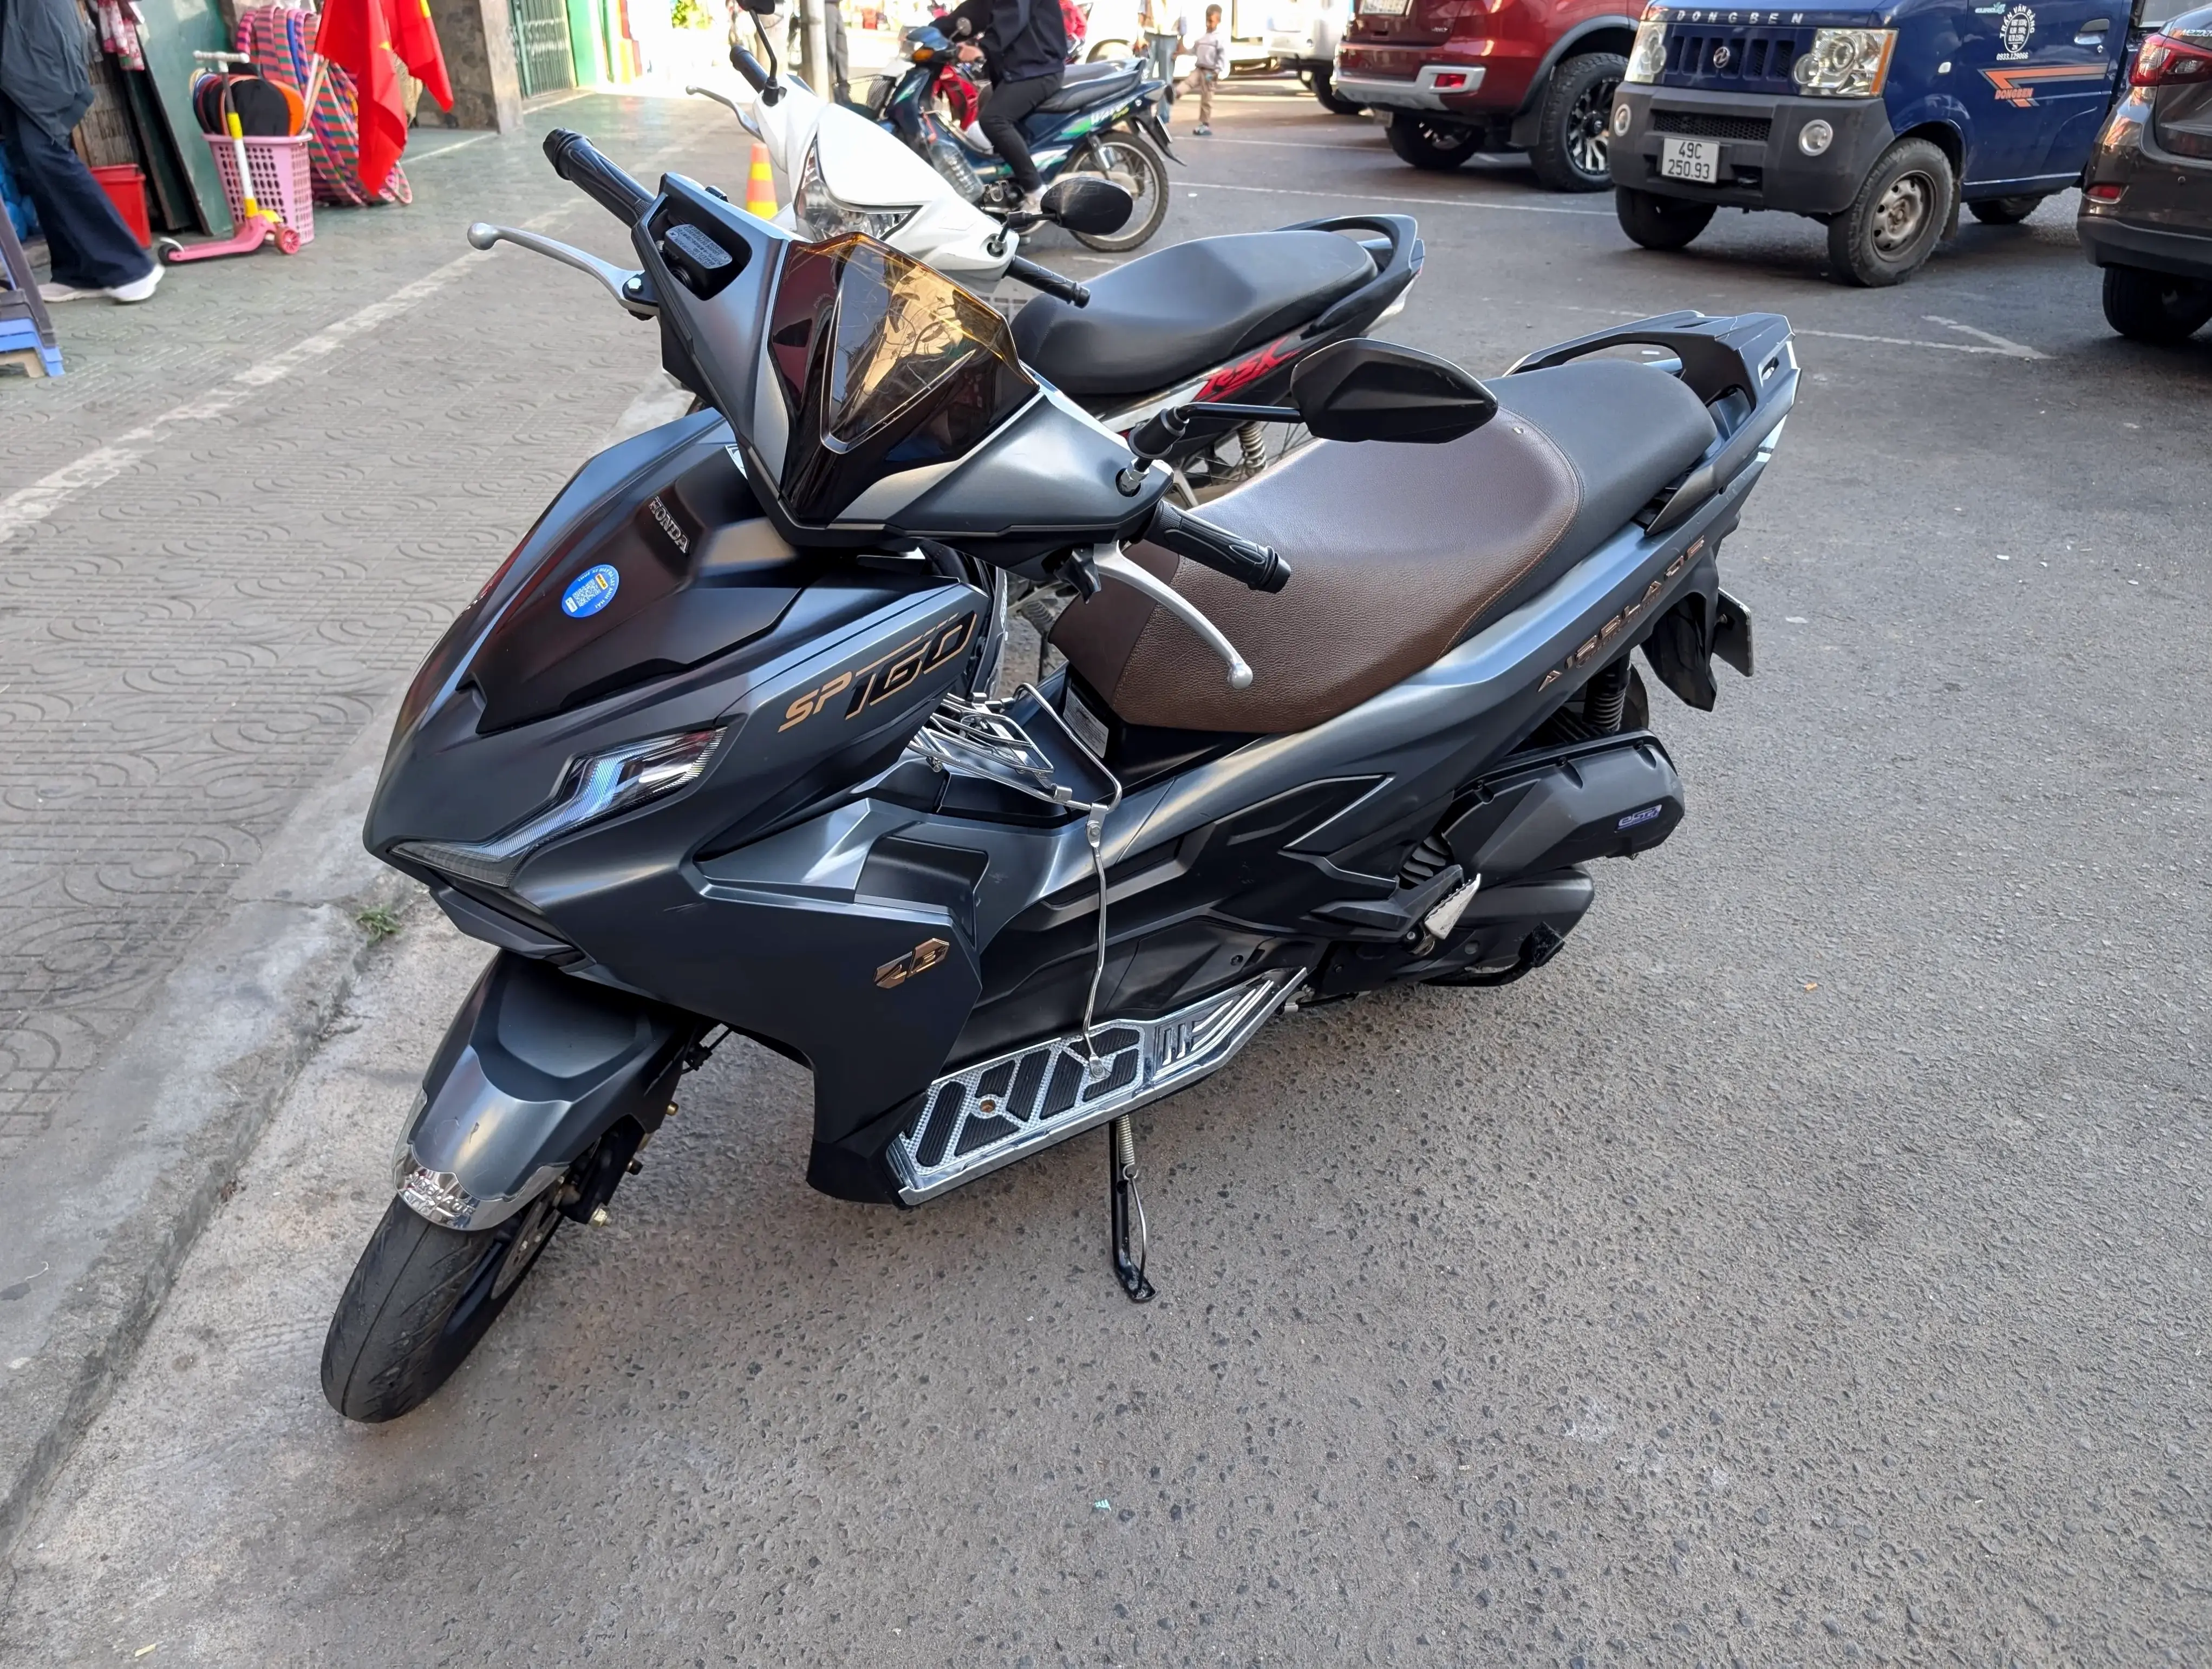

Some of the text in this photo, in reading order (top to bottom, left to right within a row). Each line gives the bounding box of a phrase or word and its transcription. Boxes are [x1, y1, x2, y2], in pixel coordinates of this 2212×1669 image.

[1676, 10, 1803, 24] DONGBEN
[1995, 88, 2034, 100] DONGBEN
[1679, 141, 1702, 159] 49C
[1668, 159, 1710, 179] 250.93
[648, 496, 688, 553] HONDA
